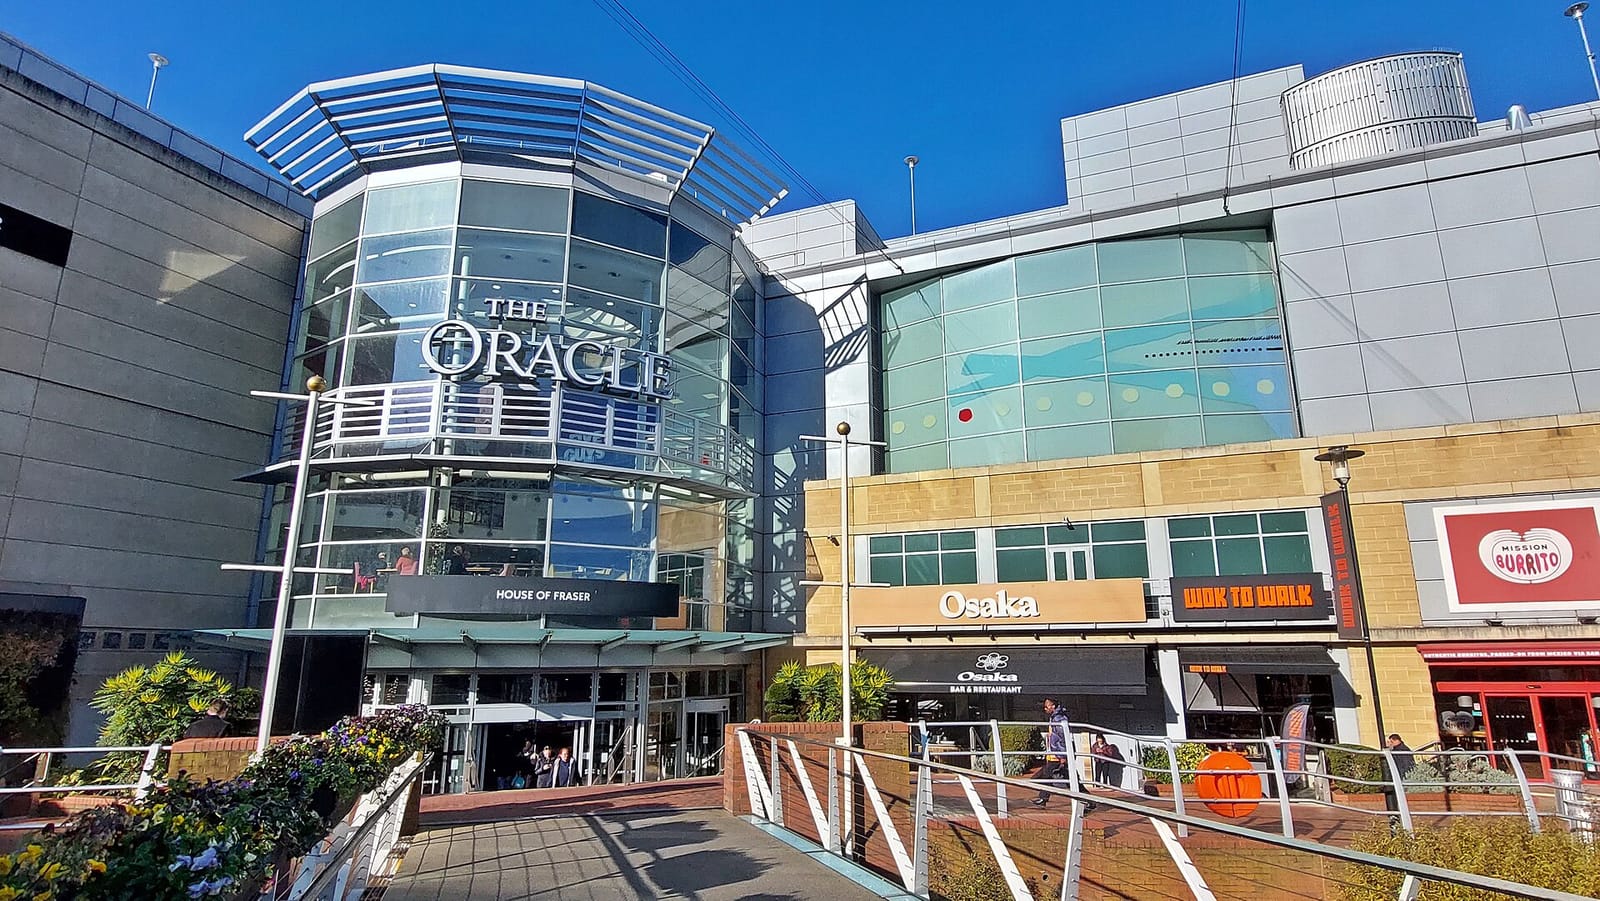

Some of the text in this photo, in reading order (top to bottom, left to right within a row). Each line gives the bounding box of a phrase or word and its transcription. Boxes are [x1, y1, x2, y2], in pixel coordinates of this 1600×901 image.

[484, 298, 548, 323] THE
[421, 319, 675, 400] ORACLE
[1502, 544, 1548, 552] MISSION
[1327, 503, 1355, 628] WOK TO WALK
[1496, 552, 1559, 575] BURRITO
[496, 589, 591, 602] HOUSE OF FRASER
[939, 590, 1040, 620] Osaka
[1183, 584, 1313, 609] WOK TO WALK
[957, 671, 1018, 682] Osaka
[950, 685, 1022, 694] BAR & RESTAURANT
